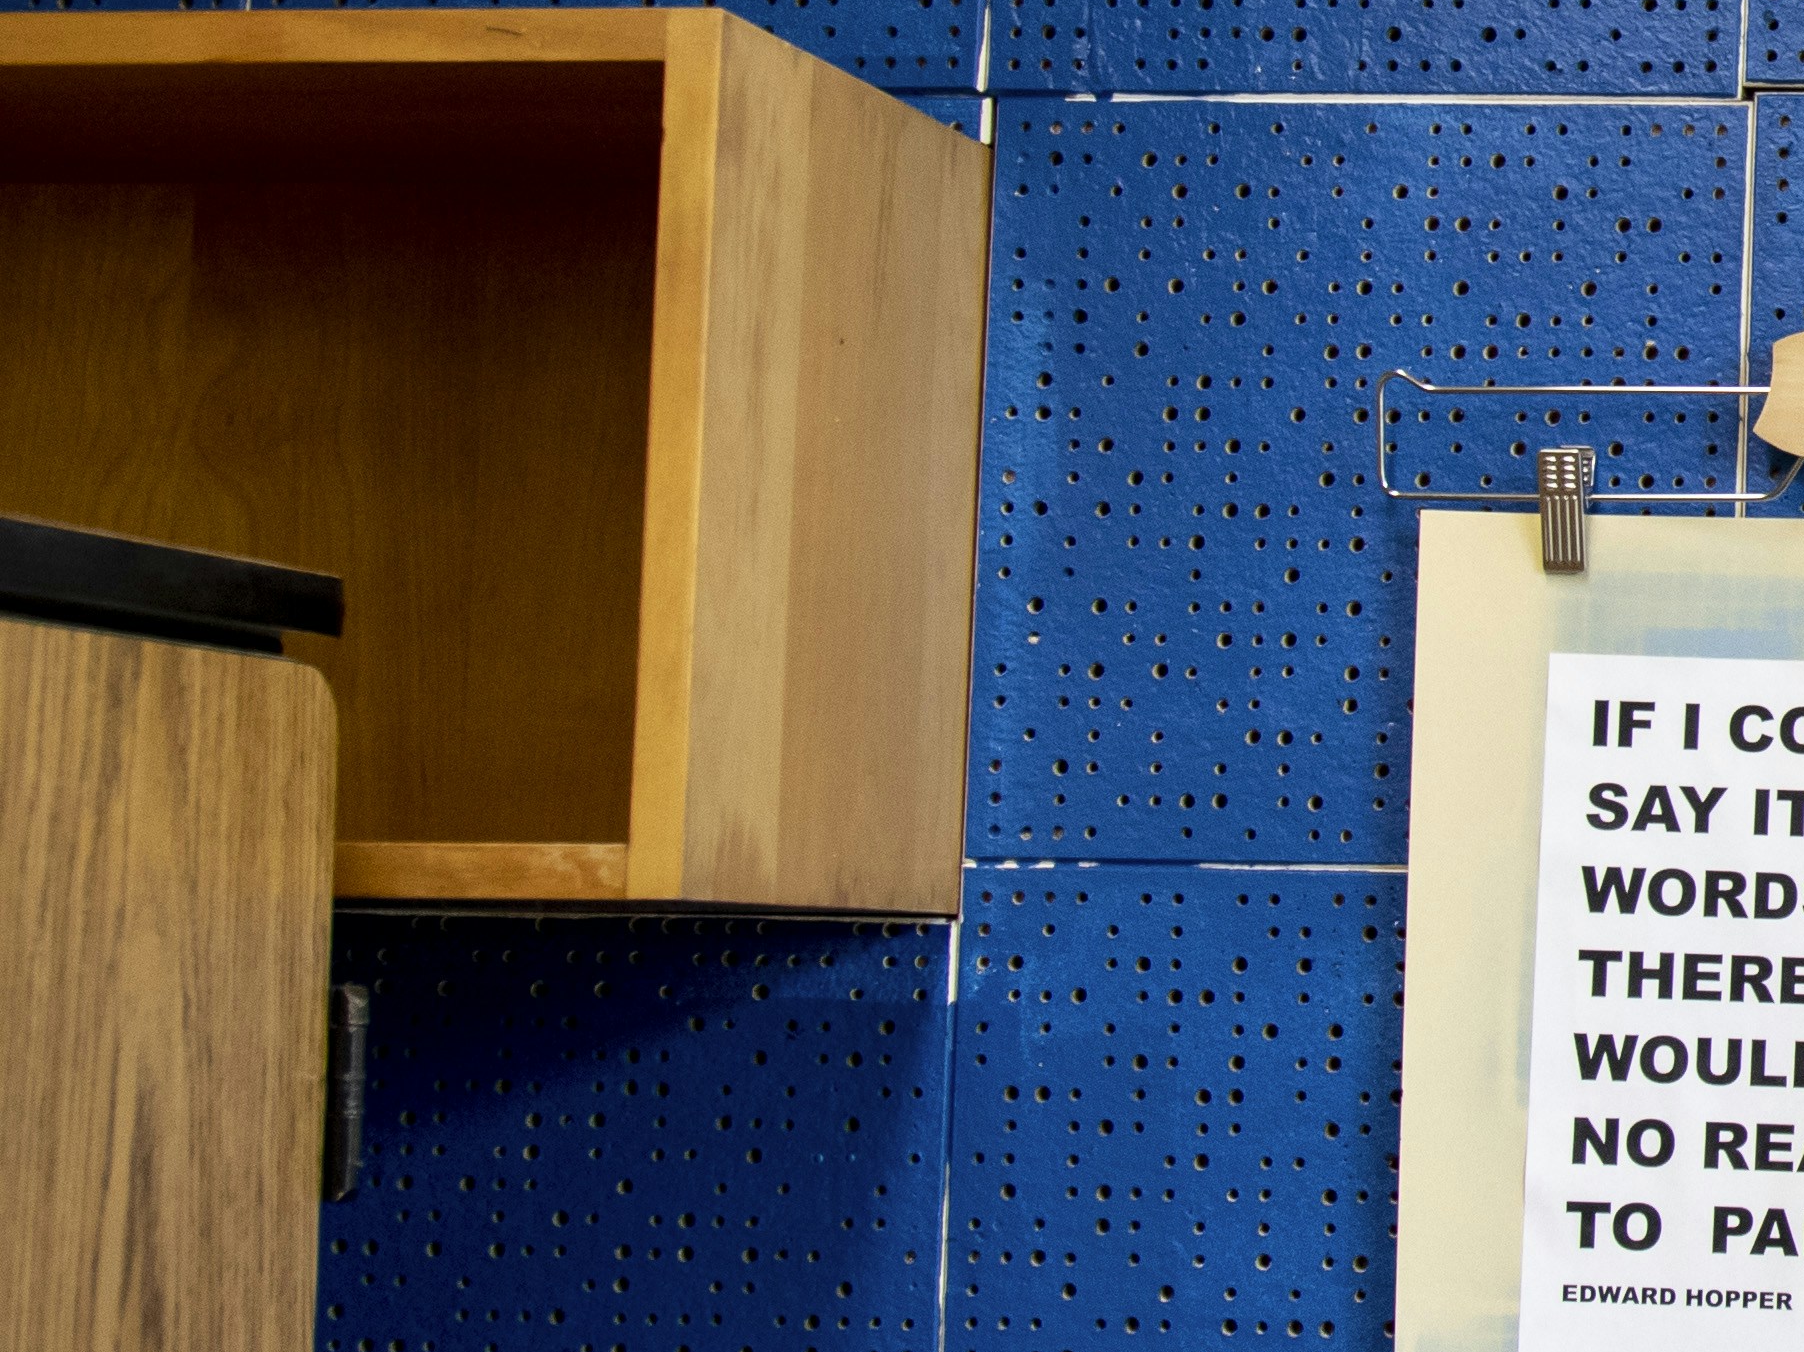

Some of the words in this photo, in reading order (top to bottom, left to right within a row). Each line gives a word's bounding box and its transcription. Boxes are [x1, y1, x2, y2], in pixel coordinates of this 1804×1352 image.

[1593, 700, 1655, 747] IF
[1684, 703, 1700, 750] I
[1586, 783, 1728, 833] SAY
[1572, 1117, 1675, 1167] NO
[1566, 1201, 1661, 1251] TO
[1563, 1285, 1676, 1305] EDWARD
[1686, 1289, 1792, 1310] HOPPER
